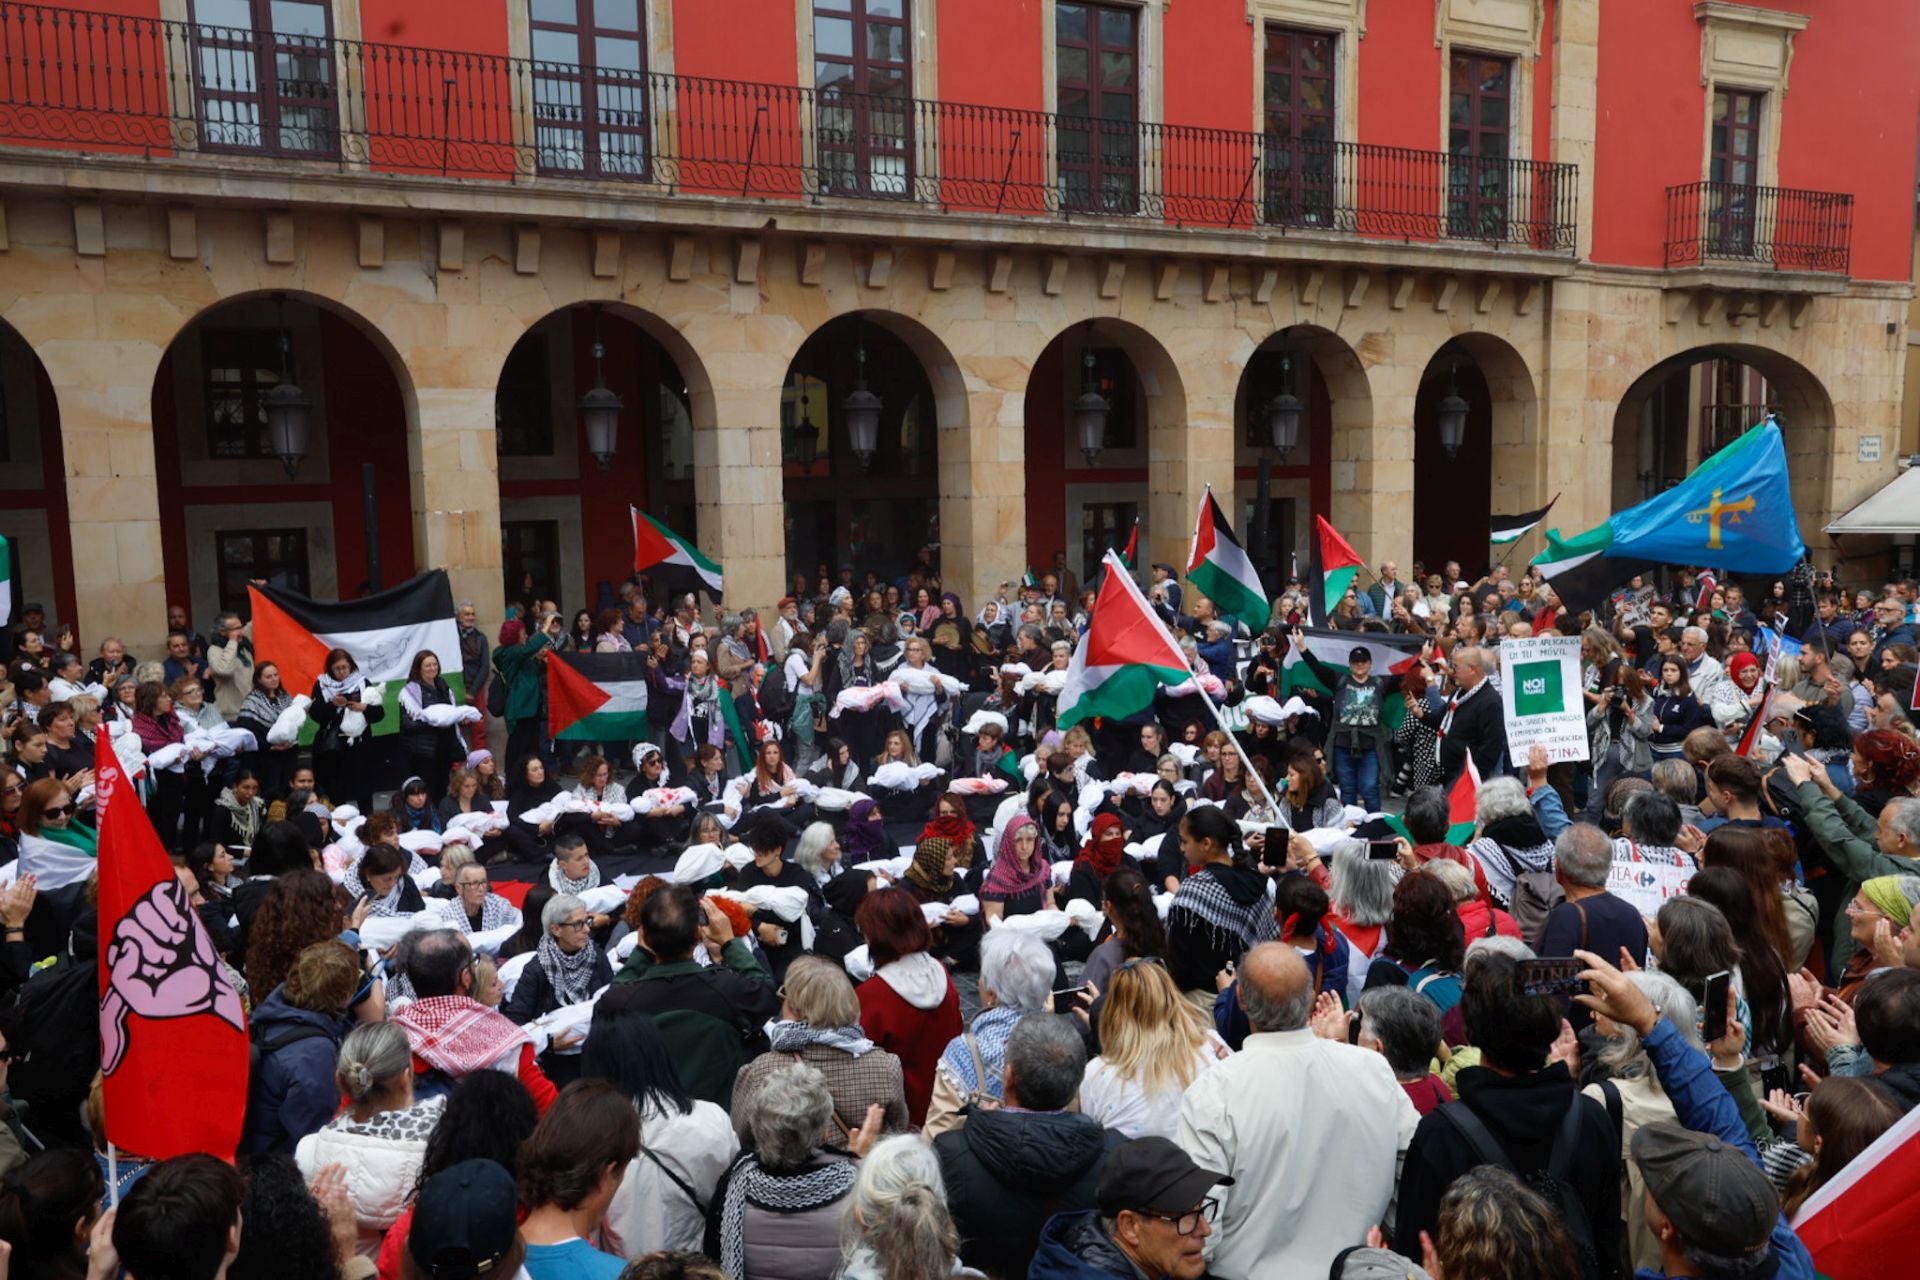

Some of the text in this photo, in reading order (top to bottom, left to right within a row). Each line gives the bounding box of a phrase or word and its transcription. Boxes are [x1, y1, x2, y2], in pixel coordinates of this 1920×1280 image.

[1519, 640, 1537, 648] ESTA
[1521, 649, 1532, 658] TU
[1540, 647, 1568, 657] MÓVIL
[1523, 677, 1545, 690] NO!
[1552, 714, 1583, 723] MARCAS
